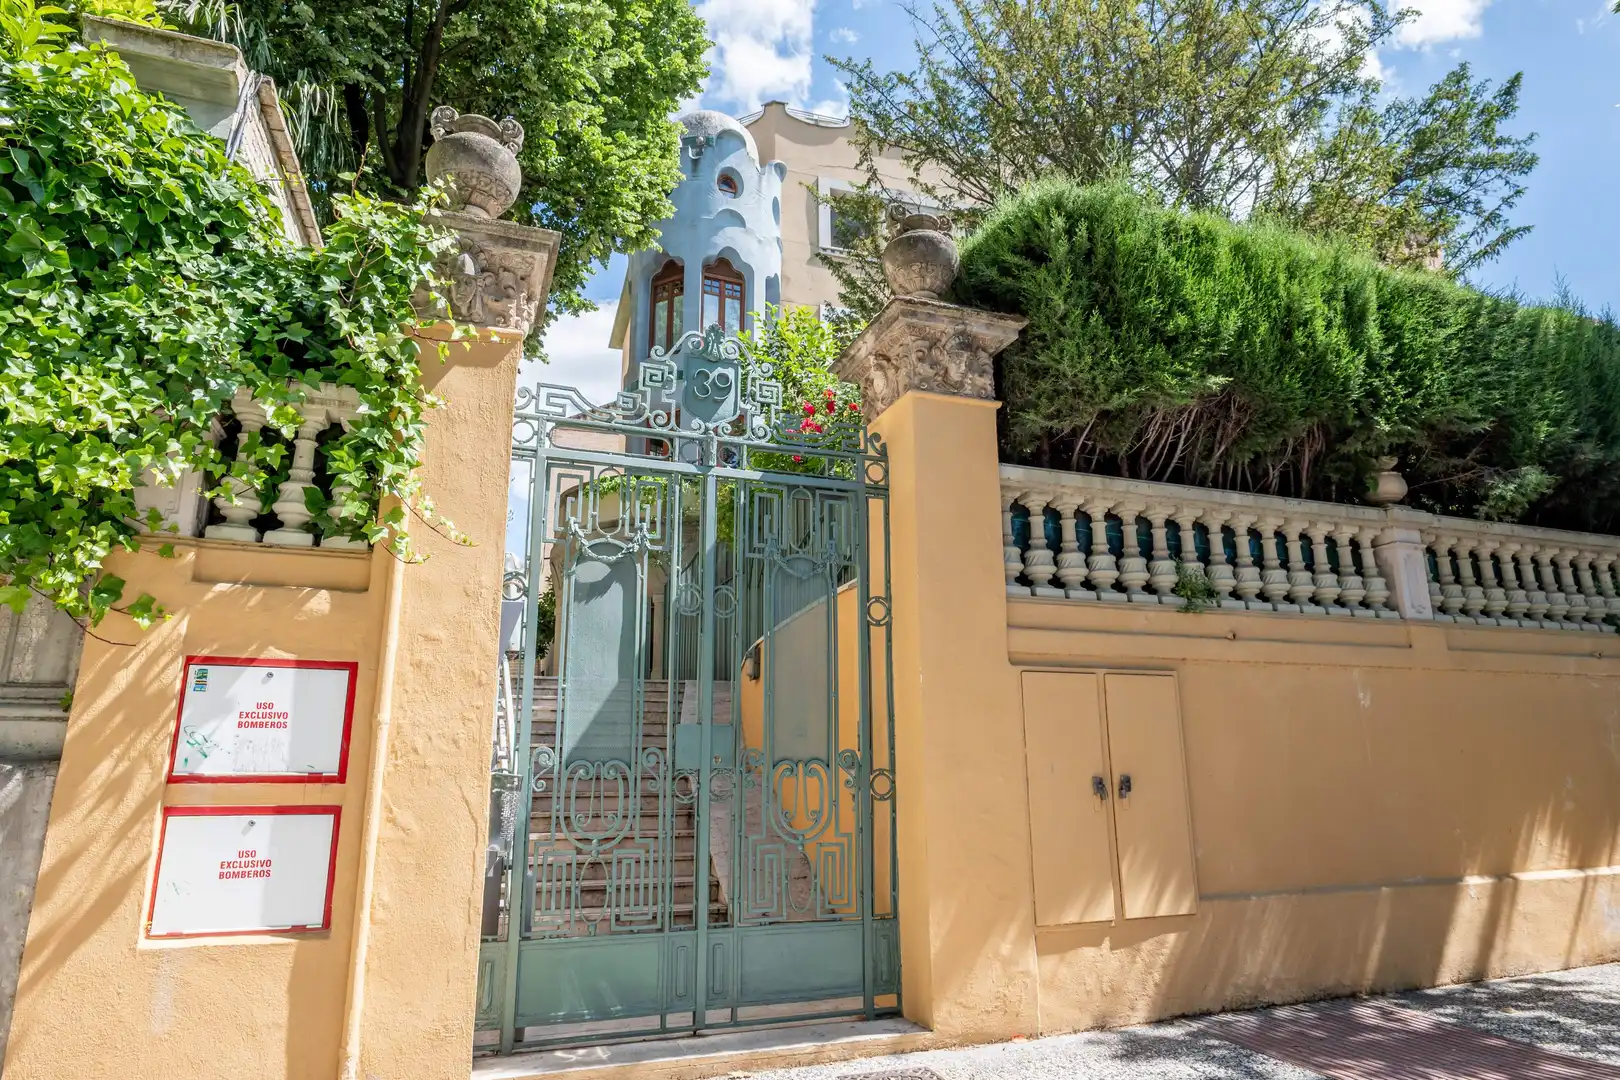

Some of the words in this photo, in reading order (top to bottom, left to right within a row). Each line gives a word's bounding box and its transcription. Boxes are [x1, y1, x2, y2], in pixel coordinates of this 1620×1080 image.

[693, 368, 732, 400] 39
[256, 702, 274, 710] USO
[238, 711, 289, 720] EXCLUSIVO
[237, 720, 288, 729] BOMBEROS
[238, 850, 256, 859] USO
[220, 859, 272, 870] EXCLUSIVO
[218, 869, 271, 880] BOMBEROS
